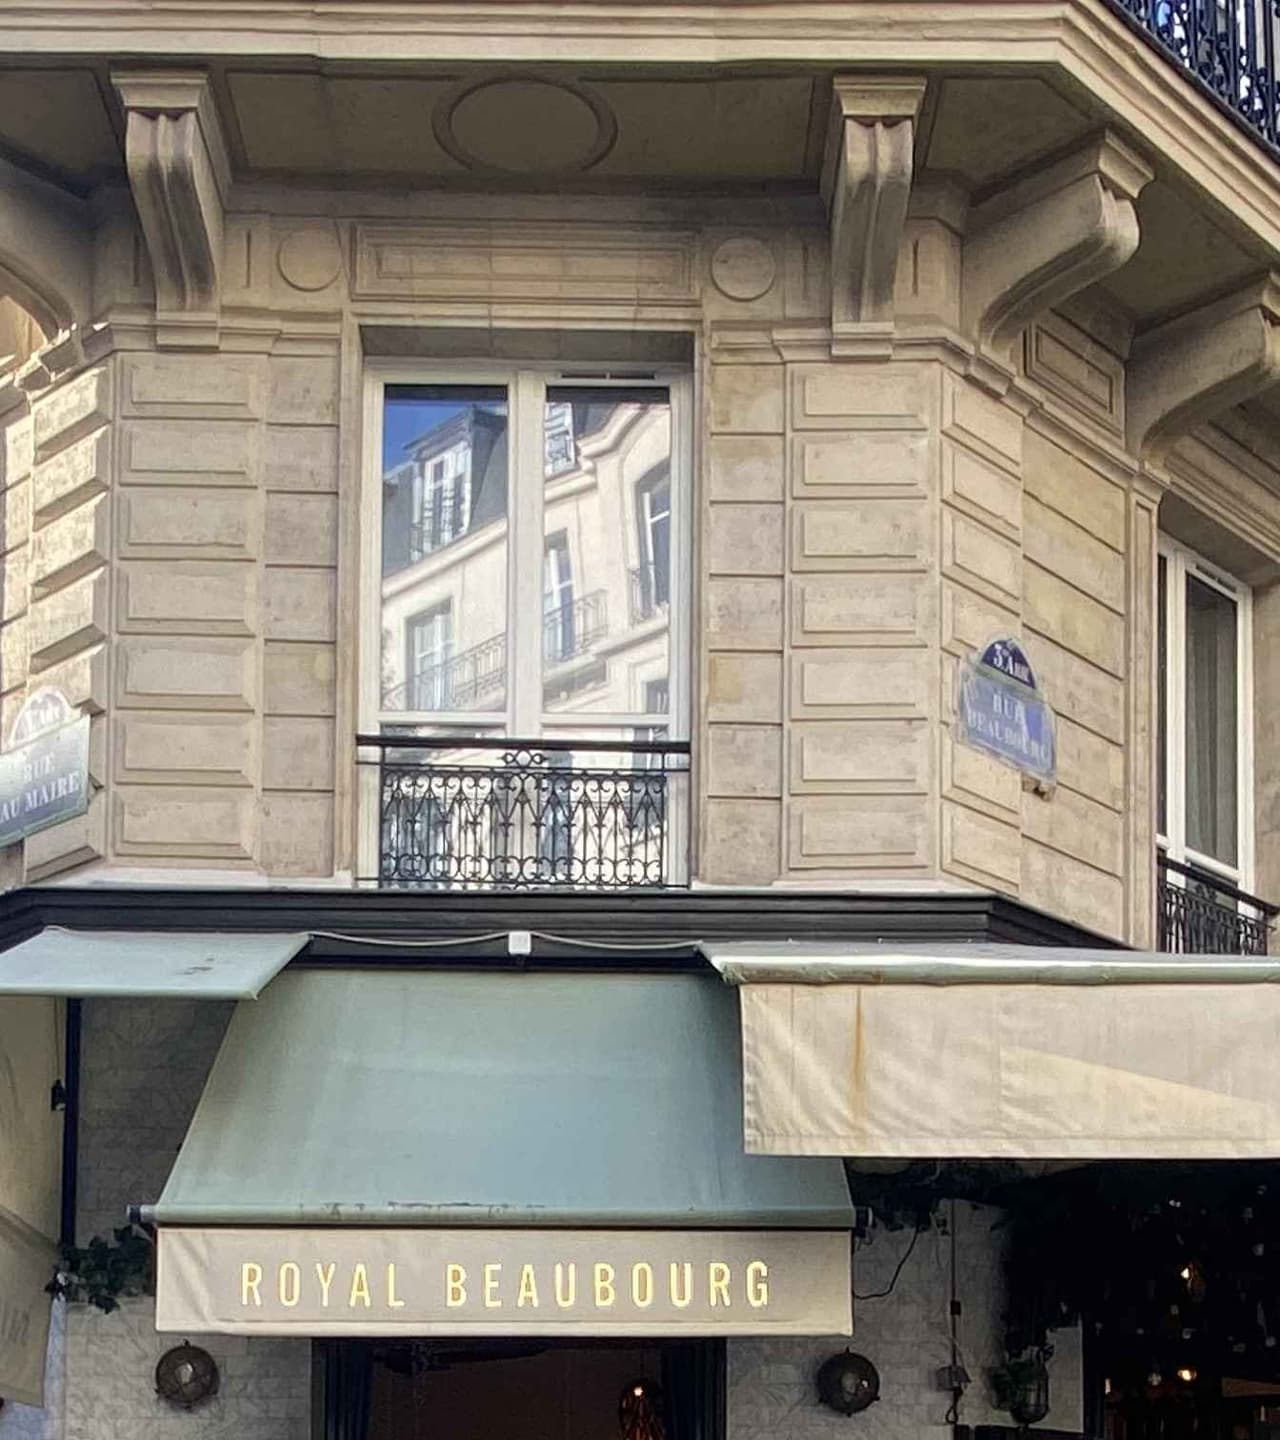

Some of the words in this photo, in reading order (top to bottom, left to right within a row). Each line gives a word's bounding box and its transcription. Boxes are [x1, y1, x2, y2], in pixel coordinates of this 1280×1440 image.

[23, 752, 56, 783] RUE
[0, 797, 21, 824] AU
[24, 771, 81, 812] MAIRE
[240, 1261, 405, 1308] ROYAL
[446, 1260, 771, 1309] BEAUBOURG
